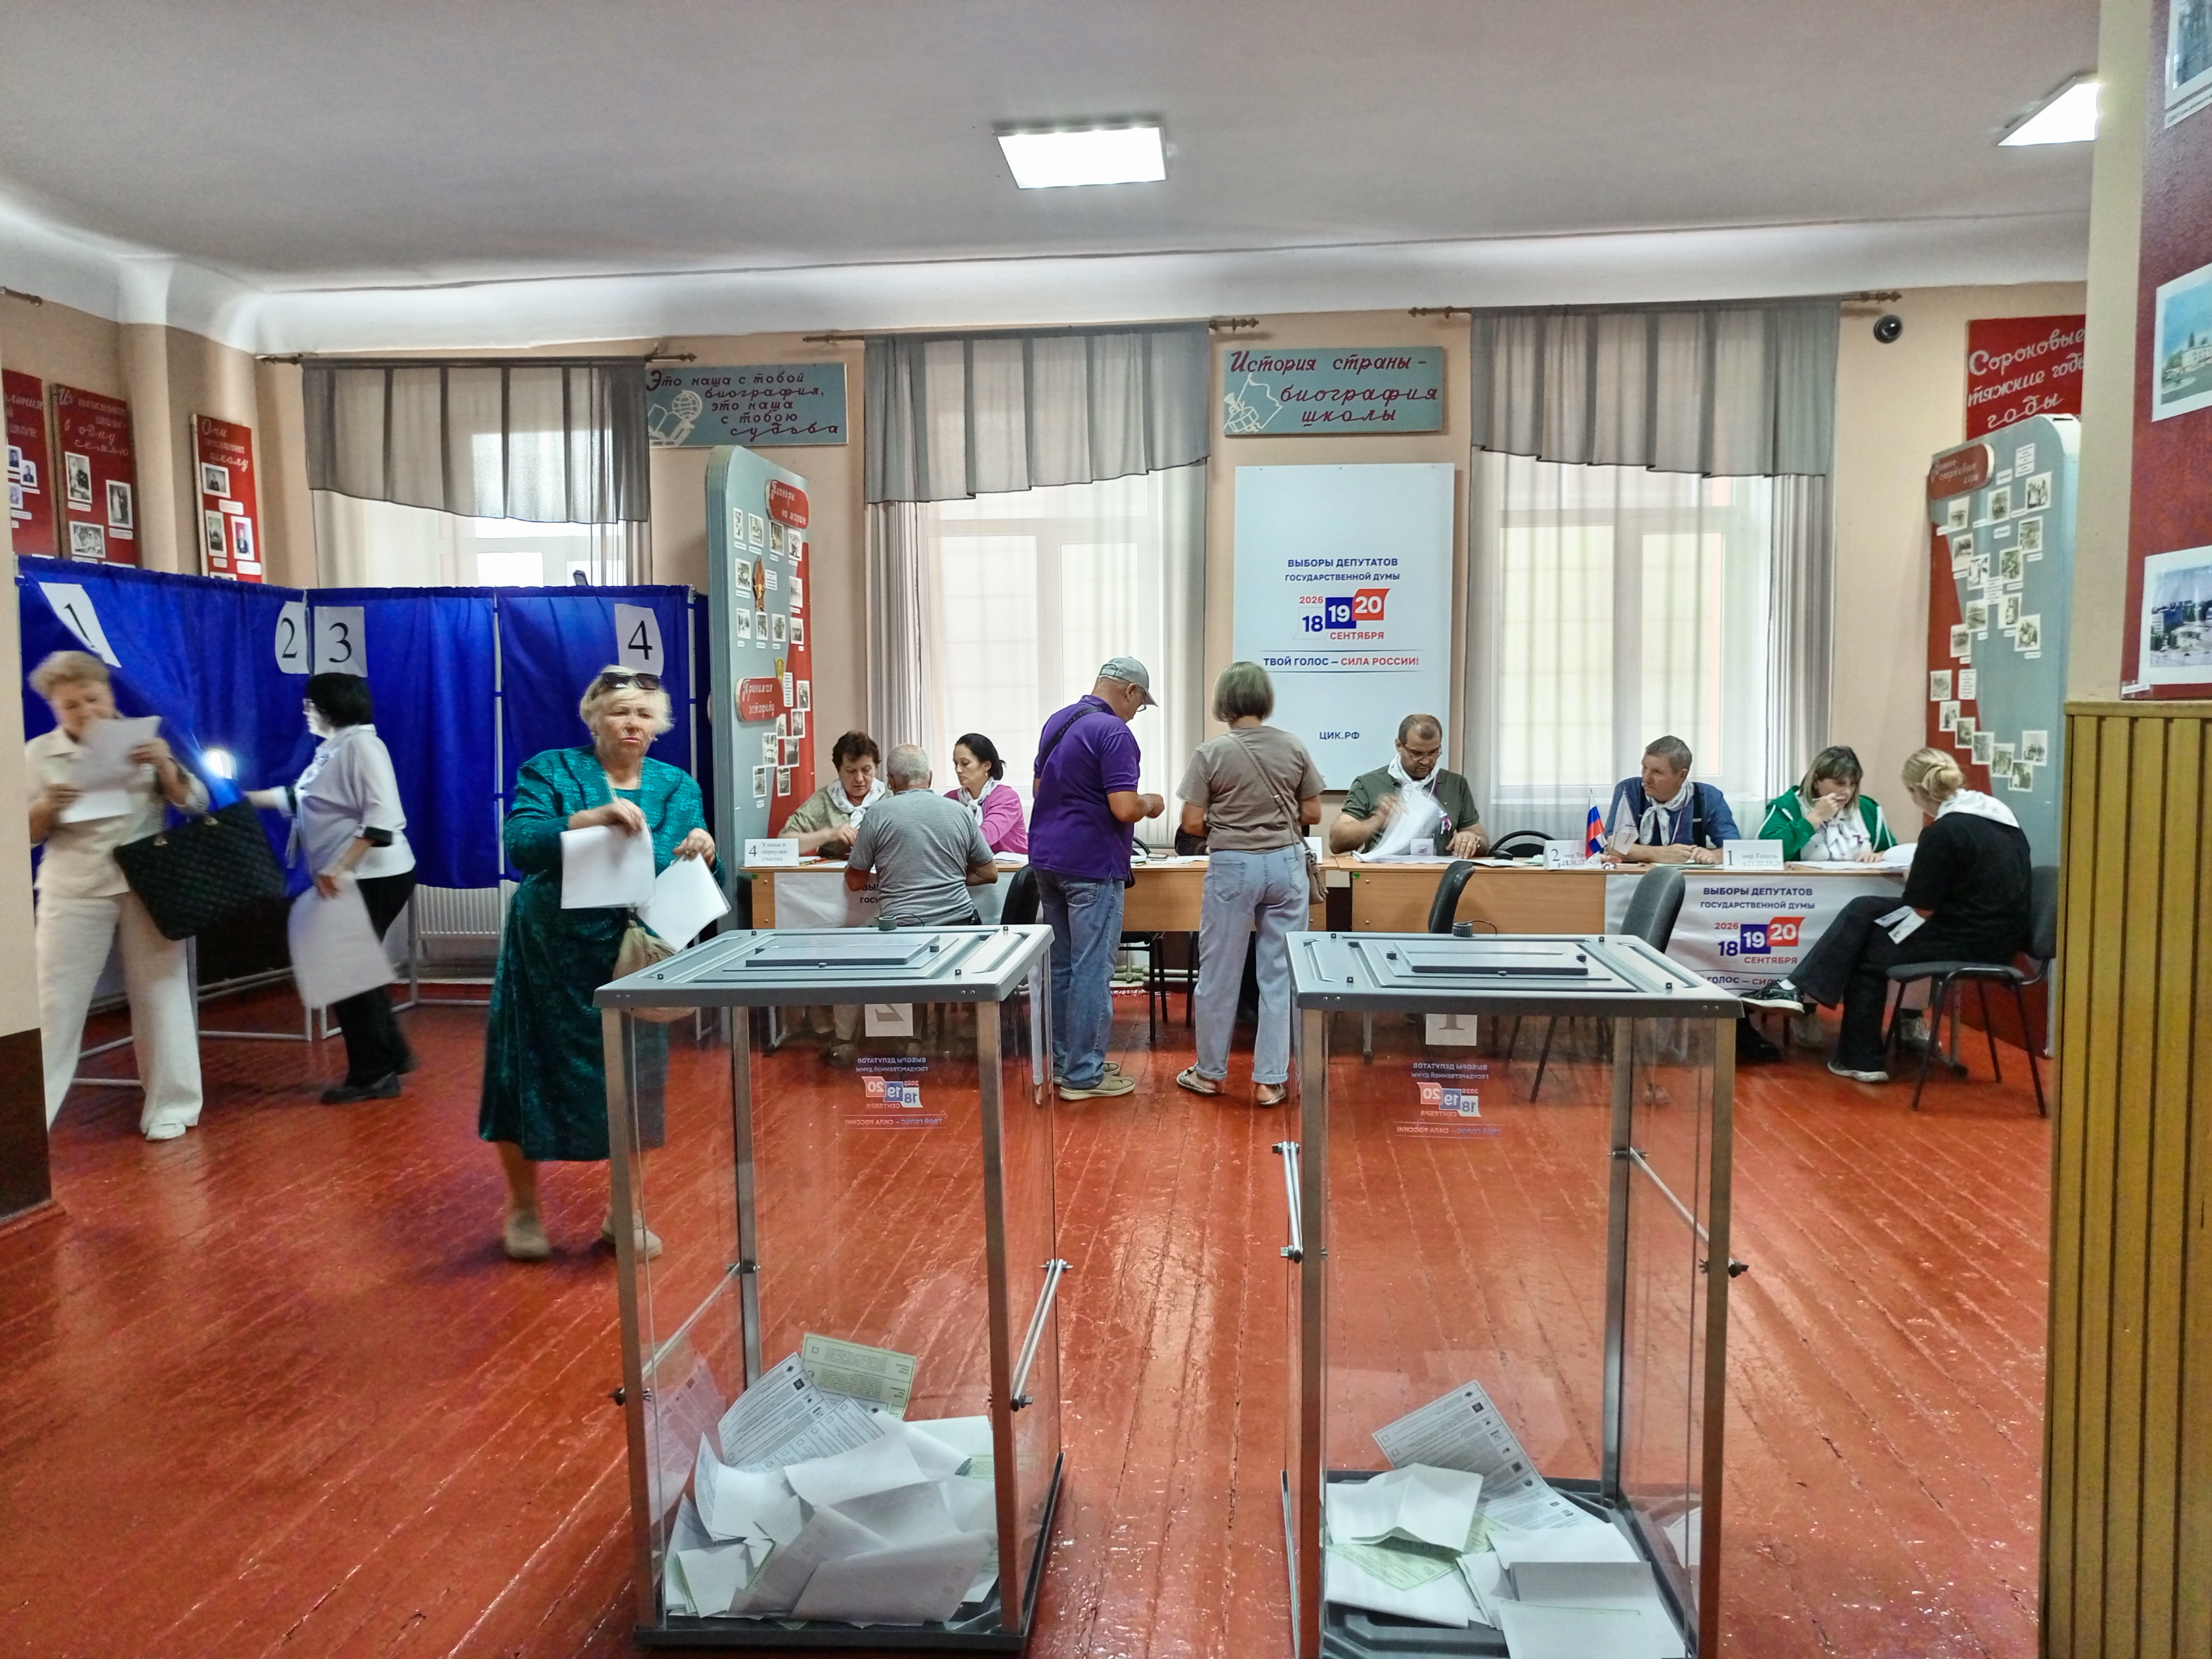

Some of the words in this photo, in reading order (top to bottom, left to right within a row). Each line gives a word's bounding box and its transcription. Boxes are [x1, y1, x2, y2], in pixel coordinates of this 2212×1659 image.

[1969, 329, 2085, 375] Сороковые
[1230, 350, 1316, 375] История
[1333, 354, 1411, 375] страны
[647, 370, 682, 391] Это
[692, 377, 731, 385] наша
[753, 372, 804, 384] тобой
[1968, 370, 2045, 407] тяжкие
[705, 385, 824, 404] биография,
[1280, 385, 1438, 406] биография
[712, 399, 739, 412] это
[749, 400, 793, 412] наша
[1987, 393, 2064, 429] годы
[721, 416, 728, 424] с
[739, 409, 797, 423] тобою
[1302, 408, 1395, 427] школы
[731, 422, 838, 442] судьба
[1287, 559, 1334, 567] ВЫБОРЫ
[1336, 558, 1398, 568] ДЕПУТАТОВ
[1285, 572, 1371, 582] ГОСУДАРСТВЕННОЙ
[1373, 573, 1400, 581] ДУМЫ
[1355, 596, 1382, 613] 20
[1328, 605, 1350, 623] 19
[64, 603, 96, 648] 1
[1302, 615, 1323, 632] 18
[281, 617, 298, 659] 2
[328, 623, 352, 663] 3
[627, 620, 653, 660] 4
[1330, 632, 1384, 640] СЕНТЯБРЯ
[1263, 656, 1291, 666] ТВОЙ
[1372, 657, 1419, 665] РОССИИ!
[1319, 732, 1360, 740] ЦИК.РФ
[749, 845, 757, 857] 4
[1551, 849, 1560, 861] 2
[1727, 850, 1733, 866] 1
[1703, 888, 1749, 896] ВЫБОРЫ
[1751, 888, 1813, 896] ДЕПУТАТОВ
[1700, 901, 1786, 909] ГОСУДАРСТВЕННОЙ
[1788, 902, 1815, 910] ДУМЫ
[1743, 931, 1765, 948] 19
[1769, 924, 1797, 940] 20
[1718, 941, 1738, 956] 18
